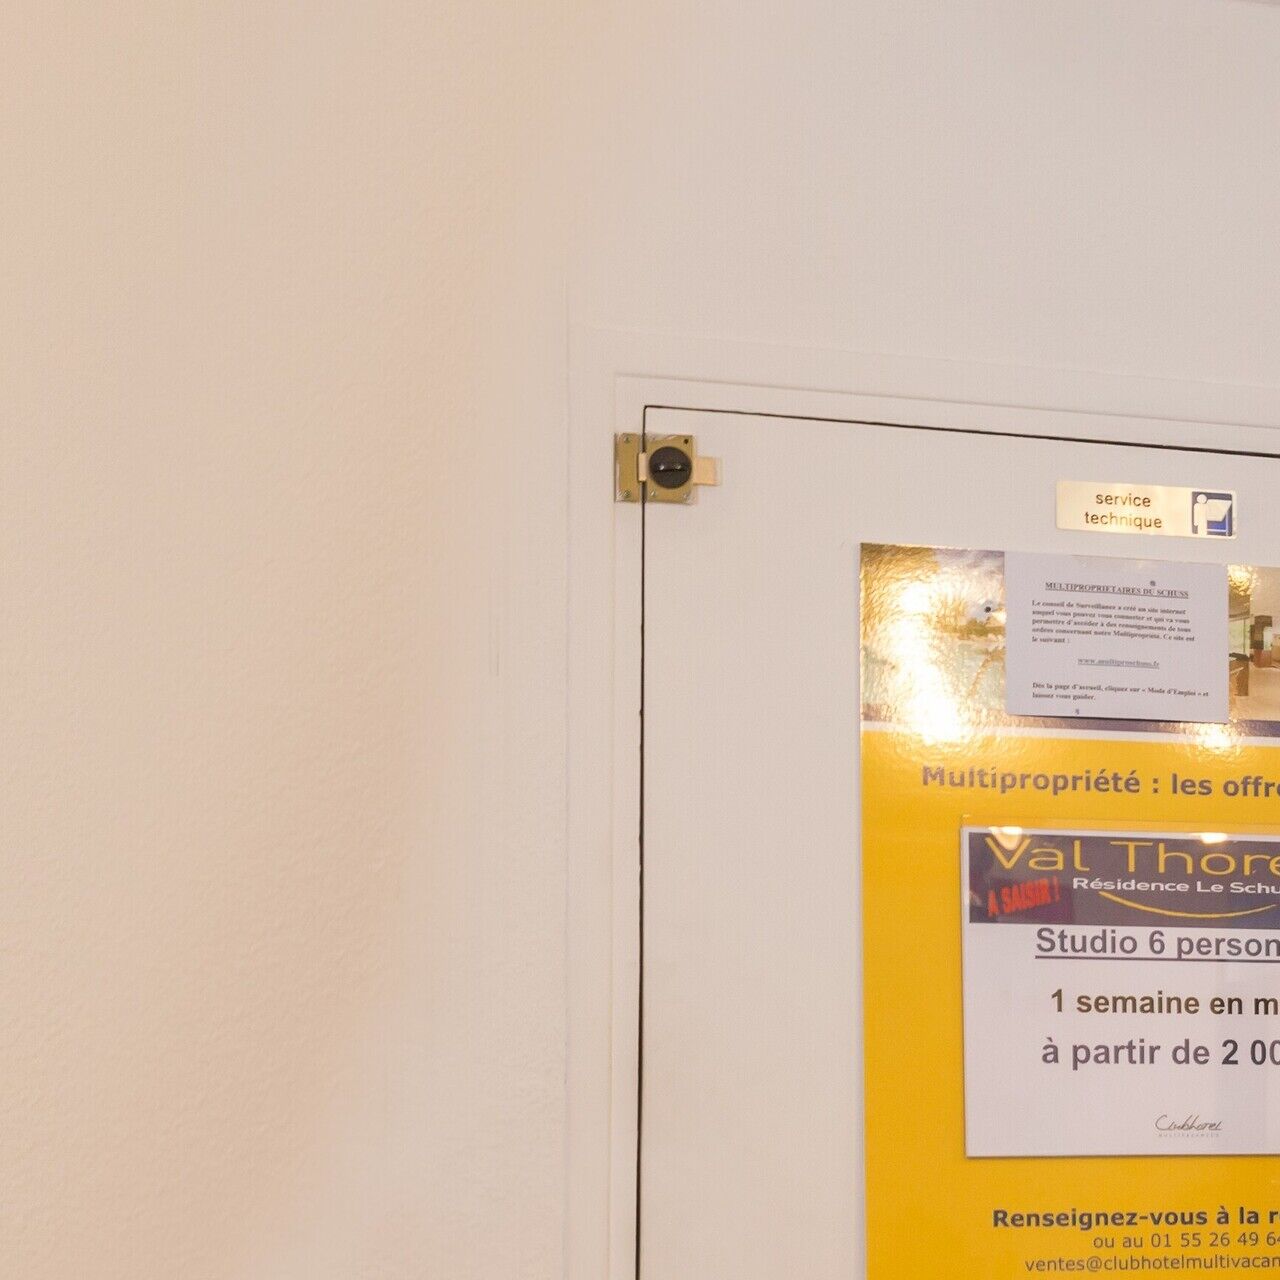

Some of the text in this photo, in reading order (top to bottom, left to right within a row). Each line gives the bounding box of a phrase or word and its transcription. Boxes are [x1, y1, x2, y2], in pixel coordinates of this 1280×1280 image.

[1095, 492, 1151, 508] service
[1084, 511, 1163, 531] technique
[921, 765, 1141, 796] Multipropriété
[1171, 772, 1213, 796] les
[984, 836, 1091, 872] Val
[1072, 876, 1190, 893] Résidence
[1196, 881, 1225, 893] Le
[1036, 927, 1138, 954] Studio
[1149, 930, 1165, 955] 6
[1051, 988, 1063, 1013] 1
[1076, 990, 1200, 1014] semaine
[1210, 996, 1243, 1015] en
[1041, 1036, 1060, 1064] à
[1071, 1038, 1161, 1071] partir
[1171, 1038, 1211, 1065] de
[1221, 1039, 1239, 1066] 2
[992, 1208, 1208, 1231] Renseignez-vous
[1216, 1205, 1230, 1225] à
[1238, 1206, 1260, 1225] la
[1092, 1235, 1115, 1249] ou
[1122, 1234, 1144, 1249] au
[1150, 1233, 1172, 1248] 01
[1179, 1233, 1202, 1248] 55
[1208, 1232, 1230, 1247] 26
[1237, 1232, 1259, 1247] 49
